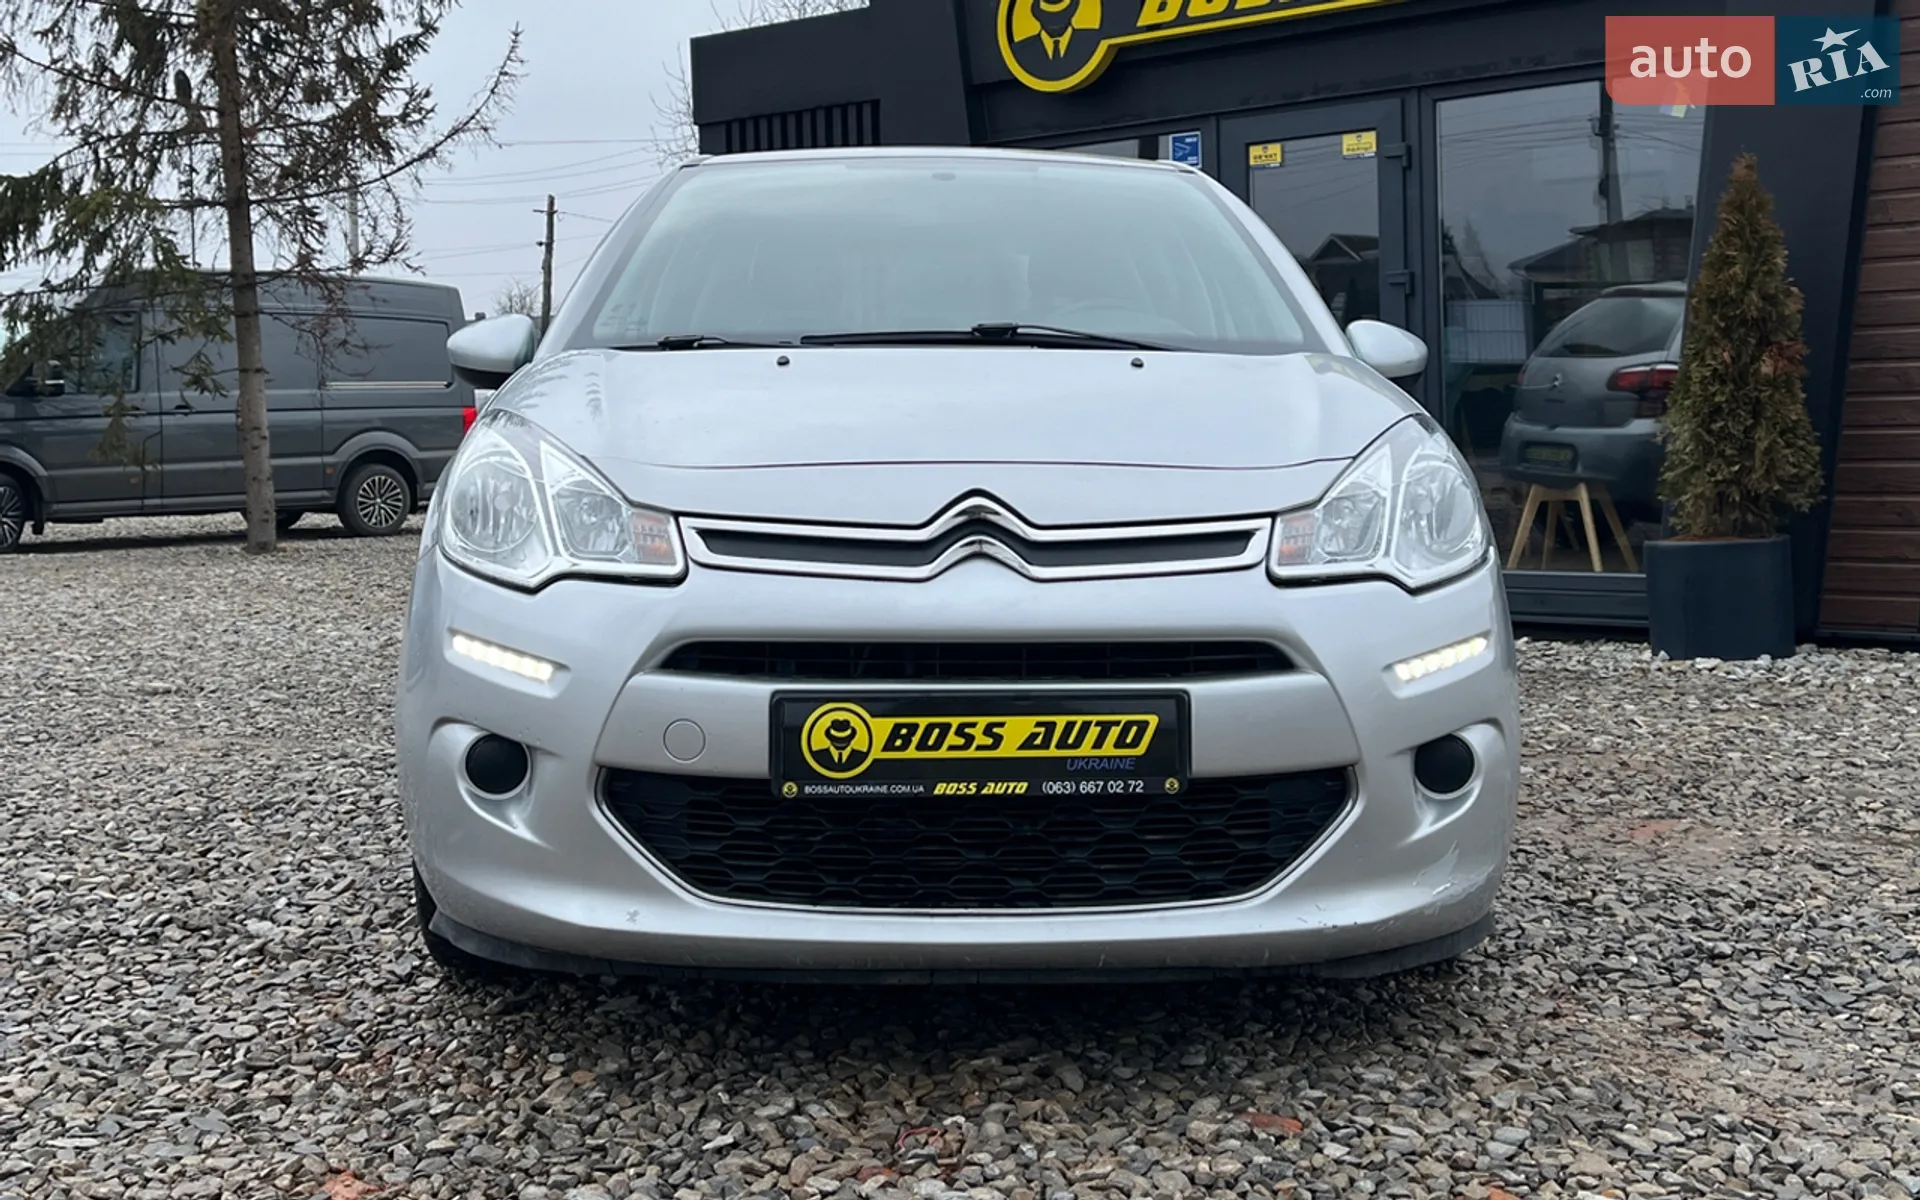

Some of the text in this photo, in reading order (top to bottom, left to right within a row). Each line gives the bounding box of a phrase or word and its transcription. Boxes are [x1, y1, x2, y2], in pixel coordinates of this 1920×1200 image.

[880, 719, 1151, 753] BOSS AUTO
[1066, 757, 1137, 770] UKRAINE
[803, 784, 926, 795] BOSSAUTOUKRAINE.COM.UA
[932, 781, 1030, 795] BOSS AUTO
[1041, 779, 1145, 795] (063) 667 02 72
